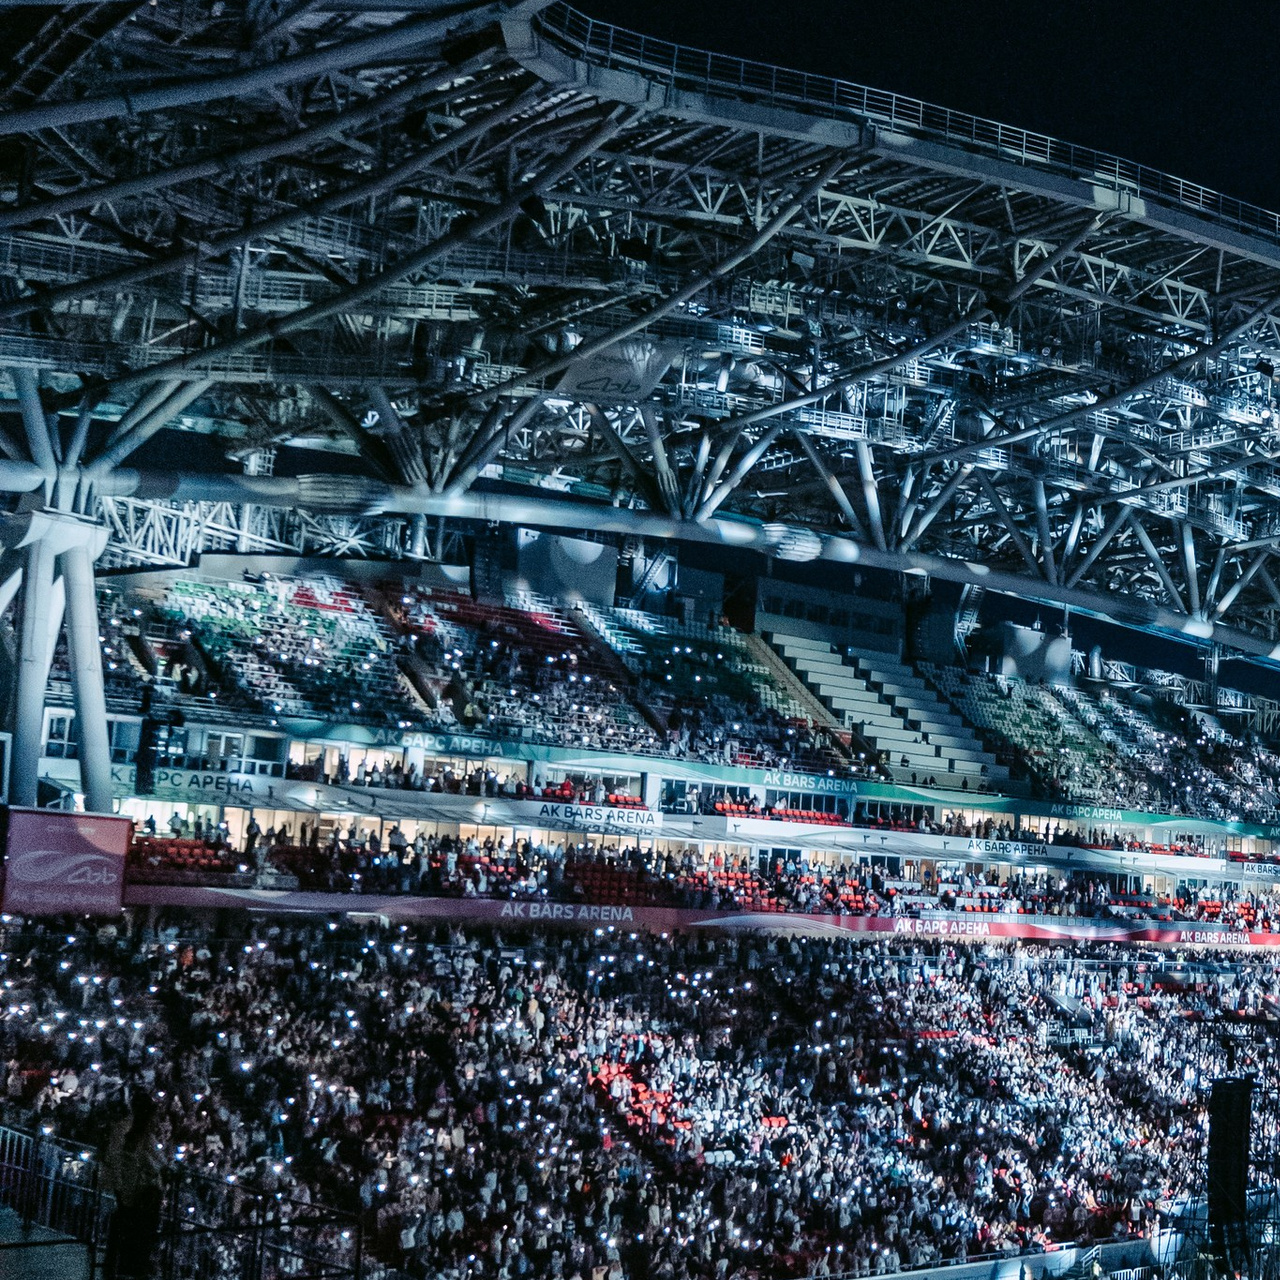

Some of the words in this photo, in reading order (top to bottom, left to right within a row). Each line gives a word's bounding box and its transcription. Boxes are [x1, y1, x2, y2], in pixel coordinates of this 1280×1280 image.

[401, 732, 446, 750] БАРС
[449, 737, 503, 756] АРЕНА
[129, 770, 182, 787] БРС
[188, 774, 253, 792] АРЕНА
[764, 772, 781, 785] AK
[783, 774, 815, 788] BARS
[817, 778, 858, 793] ARENA
[540, 804, 560, 817] AK
[564, 806, 602, 821] BARS
[608, 809, 655, 824] ARENA
[1092, 809, 1123, 820] АРЕНА
[1014, 844, 1048, 856] АРЕНА
[500, 902, 525, 917] AK
[529, 903, 574, 919] BARS
[578, 905, 633, 921] ARENA
[915, 920, 948, 934] БАРС
[950, 921, 990, 935] АРЕНА
[1180, 931, 1193, 941] AK
[1195, 931, 1219, 943] BARS
[1220, 932, 1250, 944] ARENA
